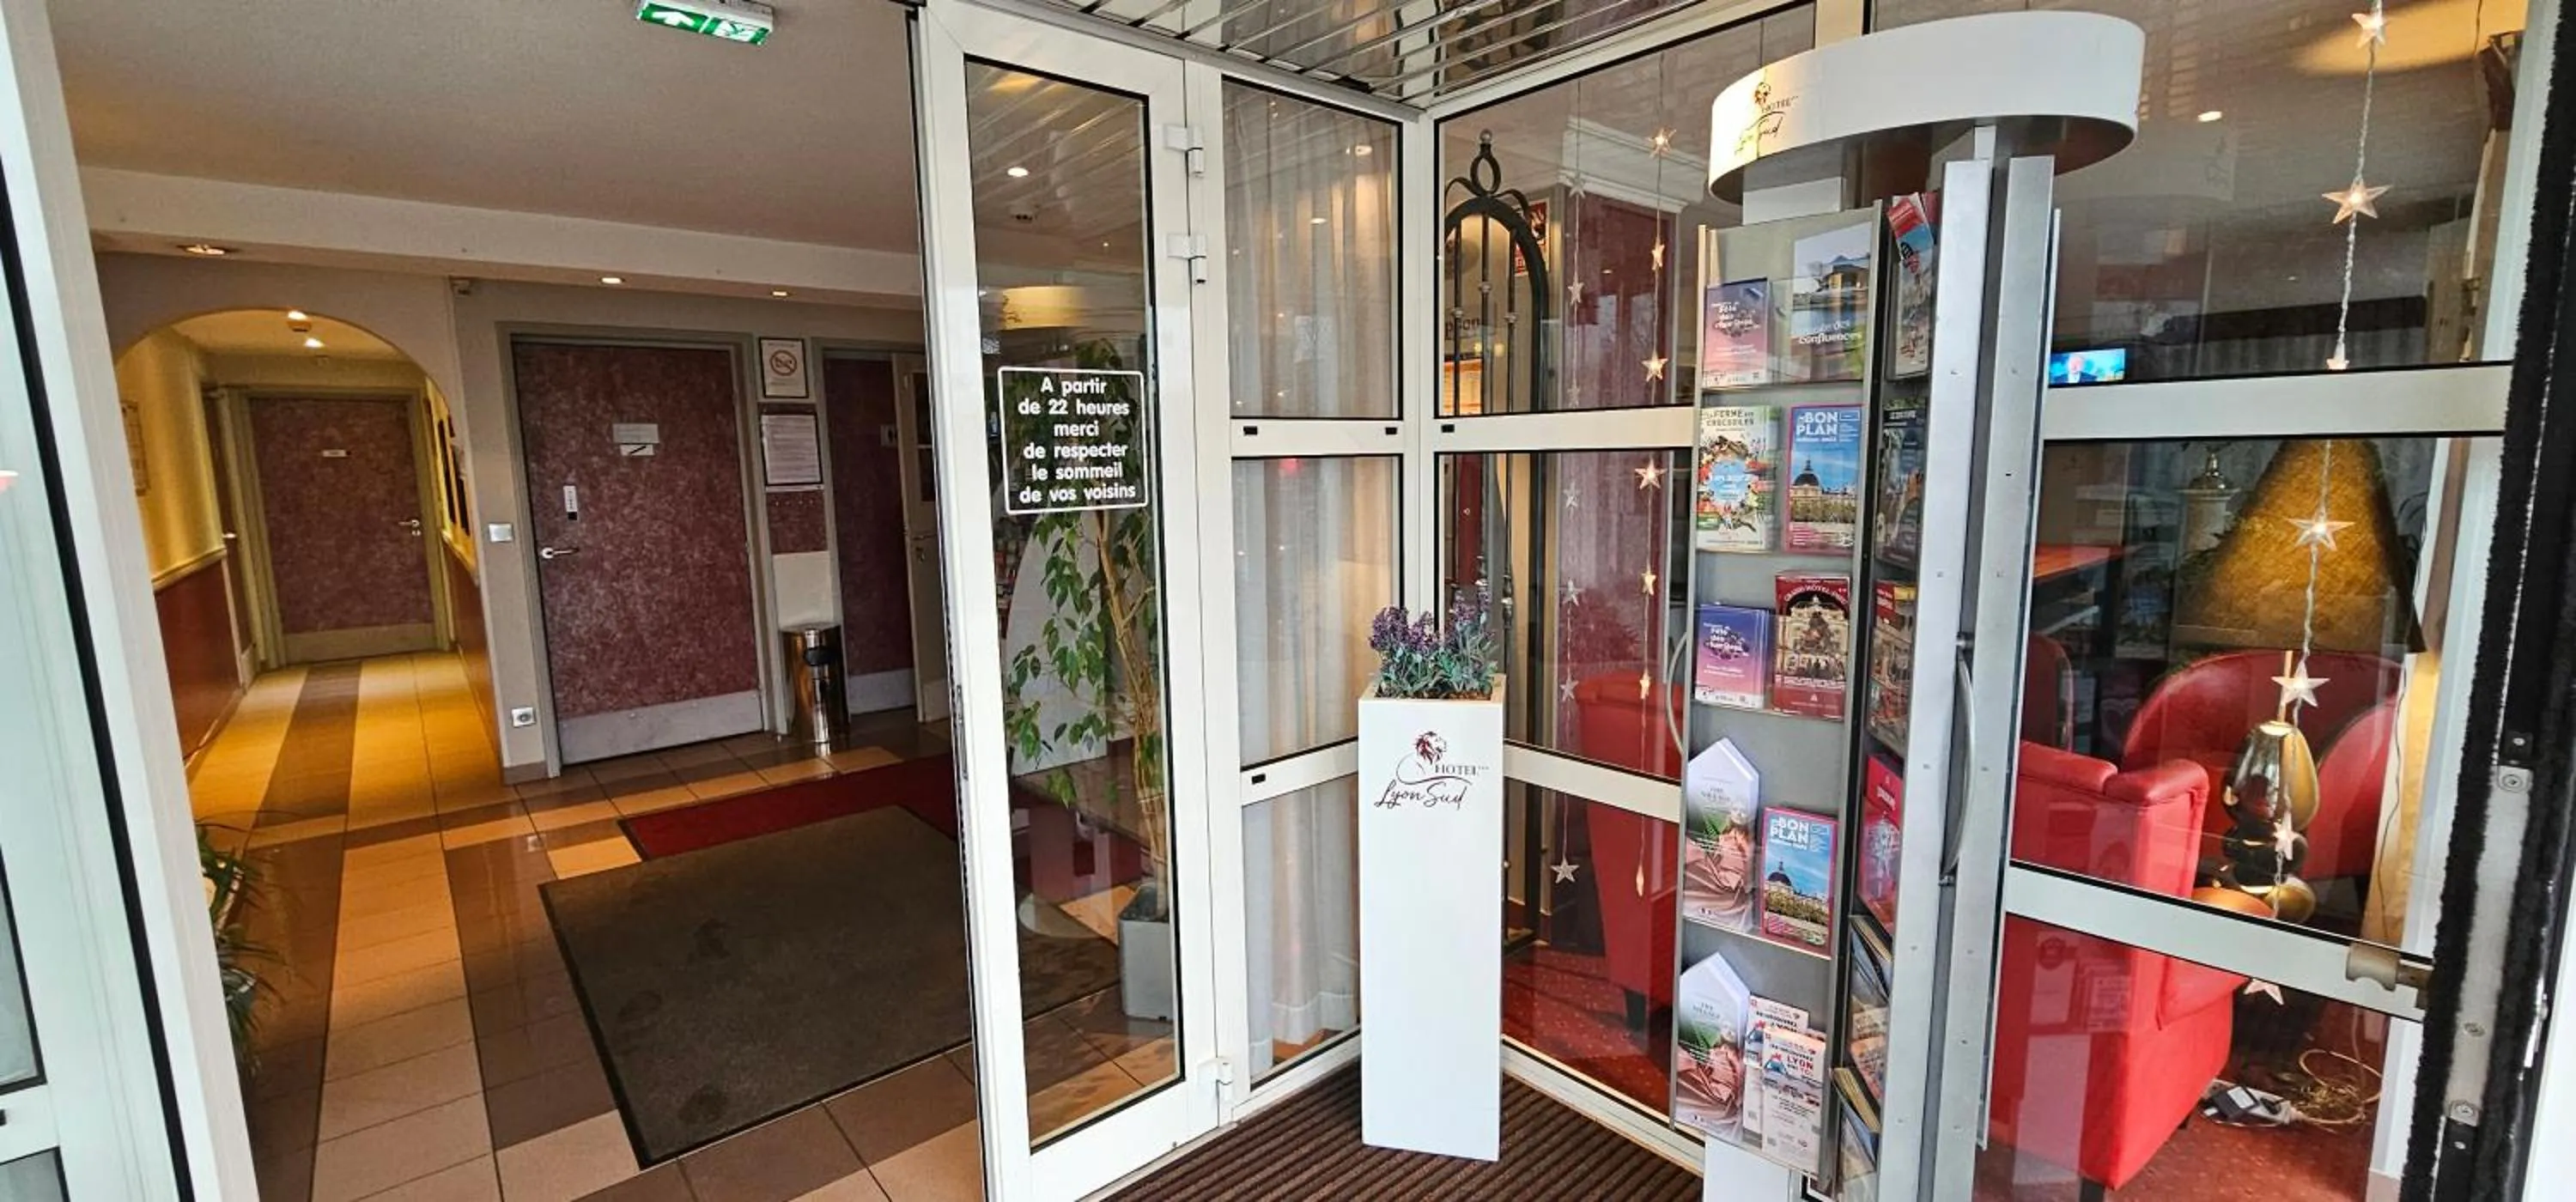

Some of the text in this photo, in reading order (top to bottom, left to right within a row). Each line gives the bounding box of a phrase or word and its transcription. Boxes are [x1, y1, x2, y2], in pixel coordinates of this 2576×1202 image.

[1040, 376, 1107, 397] A partir
[1018, 398, 1130, 416] de 22 heures
[1804, 411, 1838, 423] BON
[1054, 421, 1100, 437] merci
[1796, 423, 1838, 435] PLAN
[1023, 441, 1128, 461] de respecter
[1031, 462, 1123, 481] le sommeil
[1019, 483, 1136, 503] de vos voisins
[1435, 764, 1479, 776] HOTEL
[1374, 779, 1467, 810] Lyon Sud
[1770, 825, 1809, 844] PLAN
[1778, 817, 1810, 834] BON
[1787, 1053, 1814, 1071] LYON
